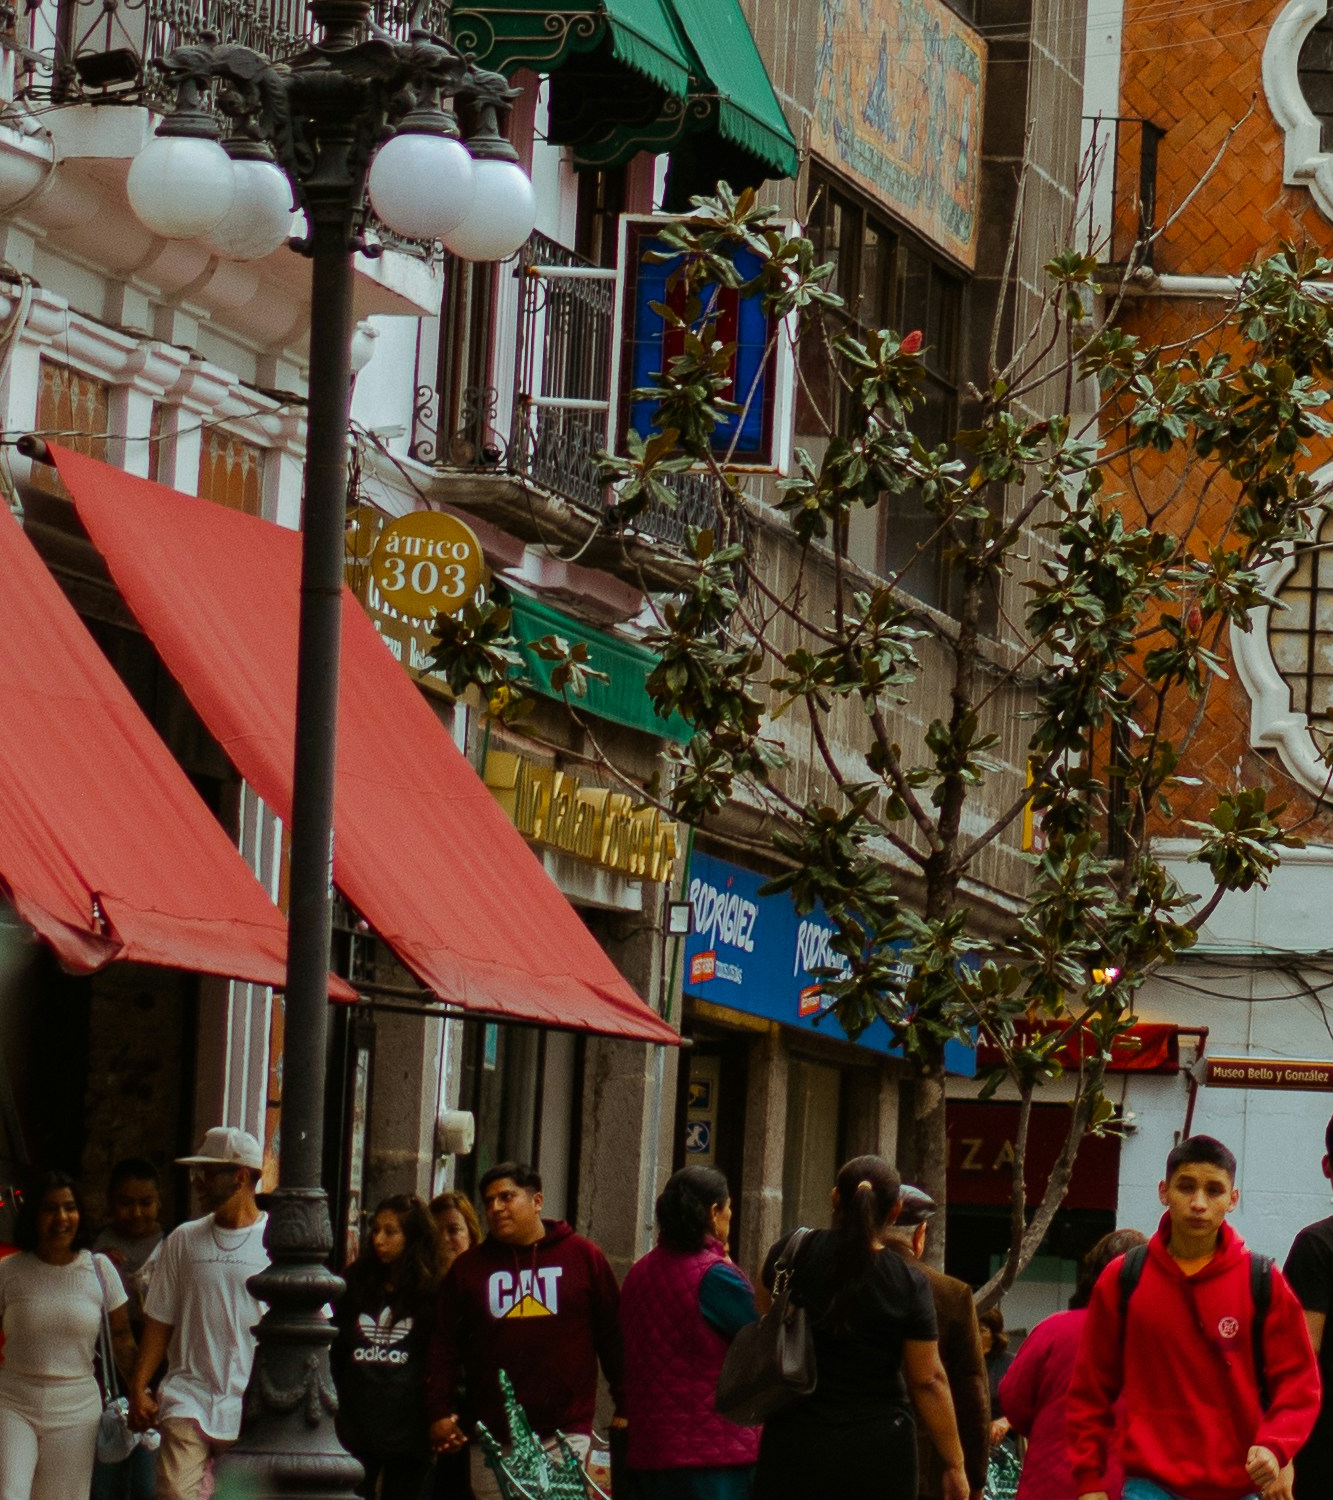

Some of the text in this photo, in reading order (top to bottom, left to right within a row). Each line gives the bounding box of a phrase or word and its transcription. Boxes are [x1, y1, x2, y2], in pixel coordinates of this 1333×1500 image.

[381, 557, 466, 598] 303
[1213, 1066, 1329, 1082] Museo Bello y González
[489, 1266, 563, 1319] CAT
